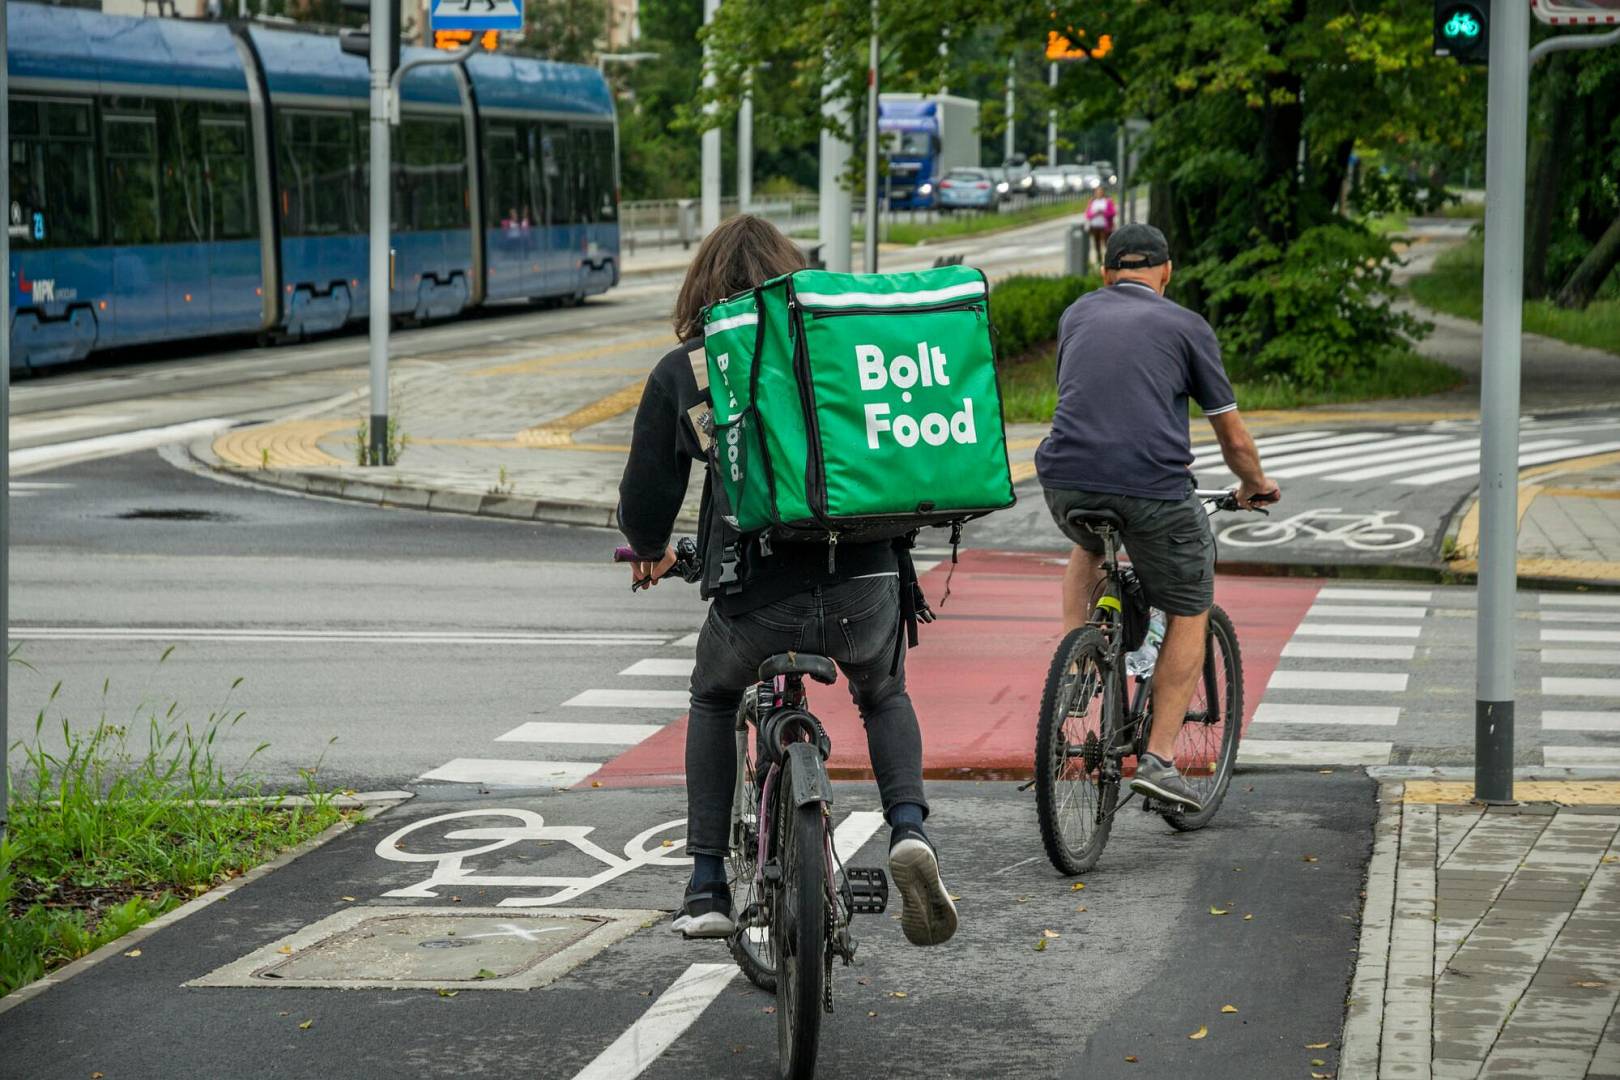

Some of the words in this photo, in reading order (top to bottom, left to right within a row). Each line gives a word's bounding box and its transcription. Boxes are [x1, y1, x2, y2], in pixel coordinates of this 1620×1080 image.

[32, 279, 55, 304] MPK
[856, 342, 949, 391] Bolt
[864, 398, 977, 450] Food
